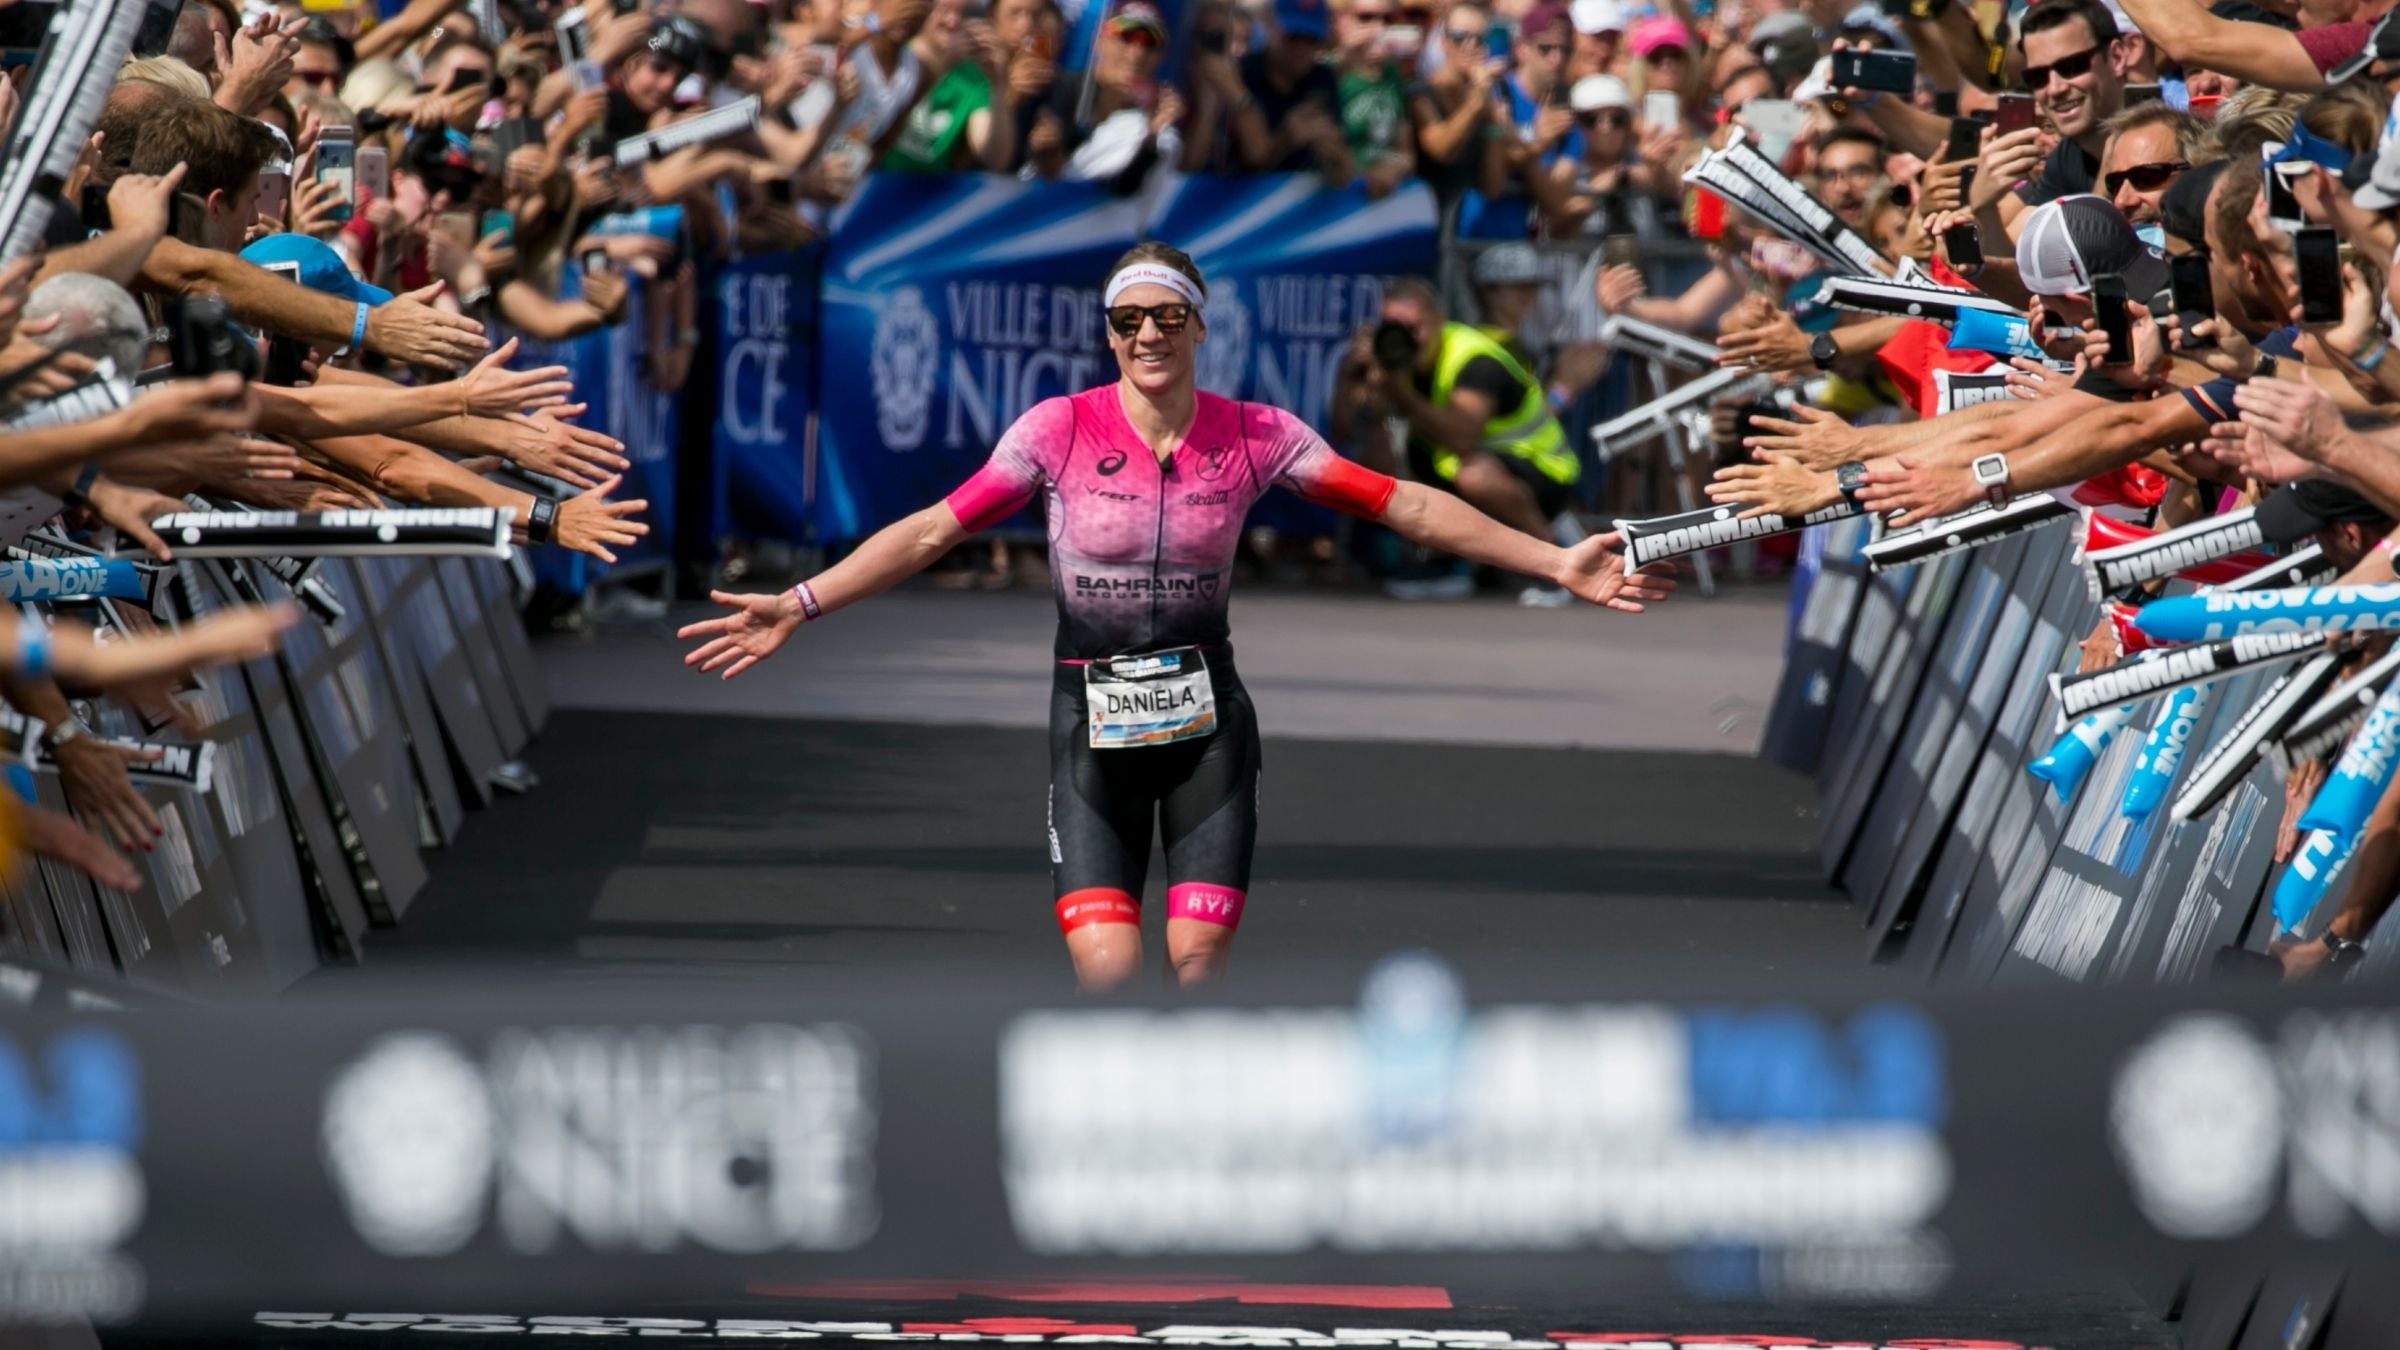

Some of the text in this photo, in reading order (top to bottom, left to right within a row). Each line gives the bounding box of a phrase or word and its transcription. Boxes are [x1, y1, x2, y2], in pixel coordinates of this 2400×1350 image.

[1120, 270, 1167, 282] Red Bull
[946, 281, 1047, 346] VILLE
[1634, 513, 1784, 563] IRONMAN
[2103, 519, 2264, 586] IRONMAN
[61, 568, 108, 595] ONE
[1076, 575, 1195, 591] BAHRAIN
[1076, 590, 1196, 599] ENDURANCE
[2062, 644, 2217, 716] IRONMAN
[1107, 686, 1196, 714] DANIELA
[1187, 897, 1234, 916] RYF
